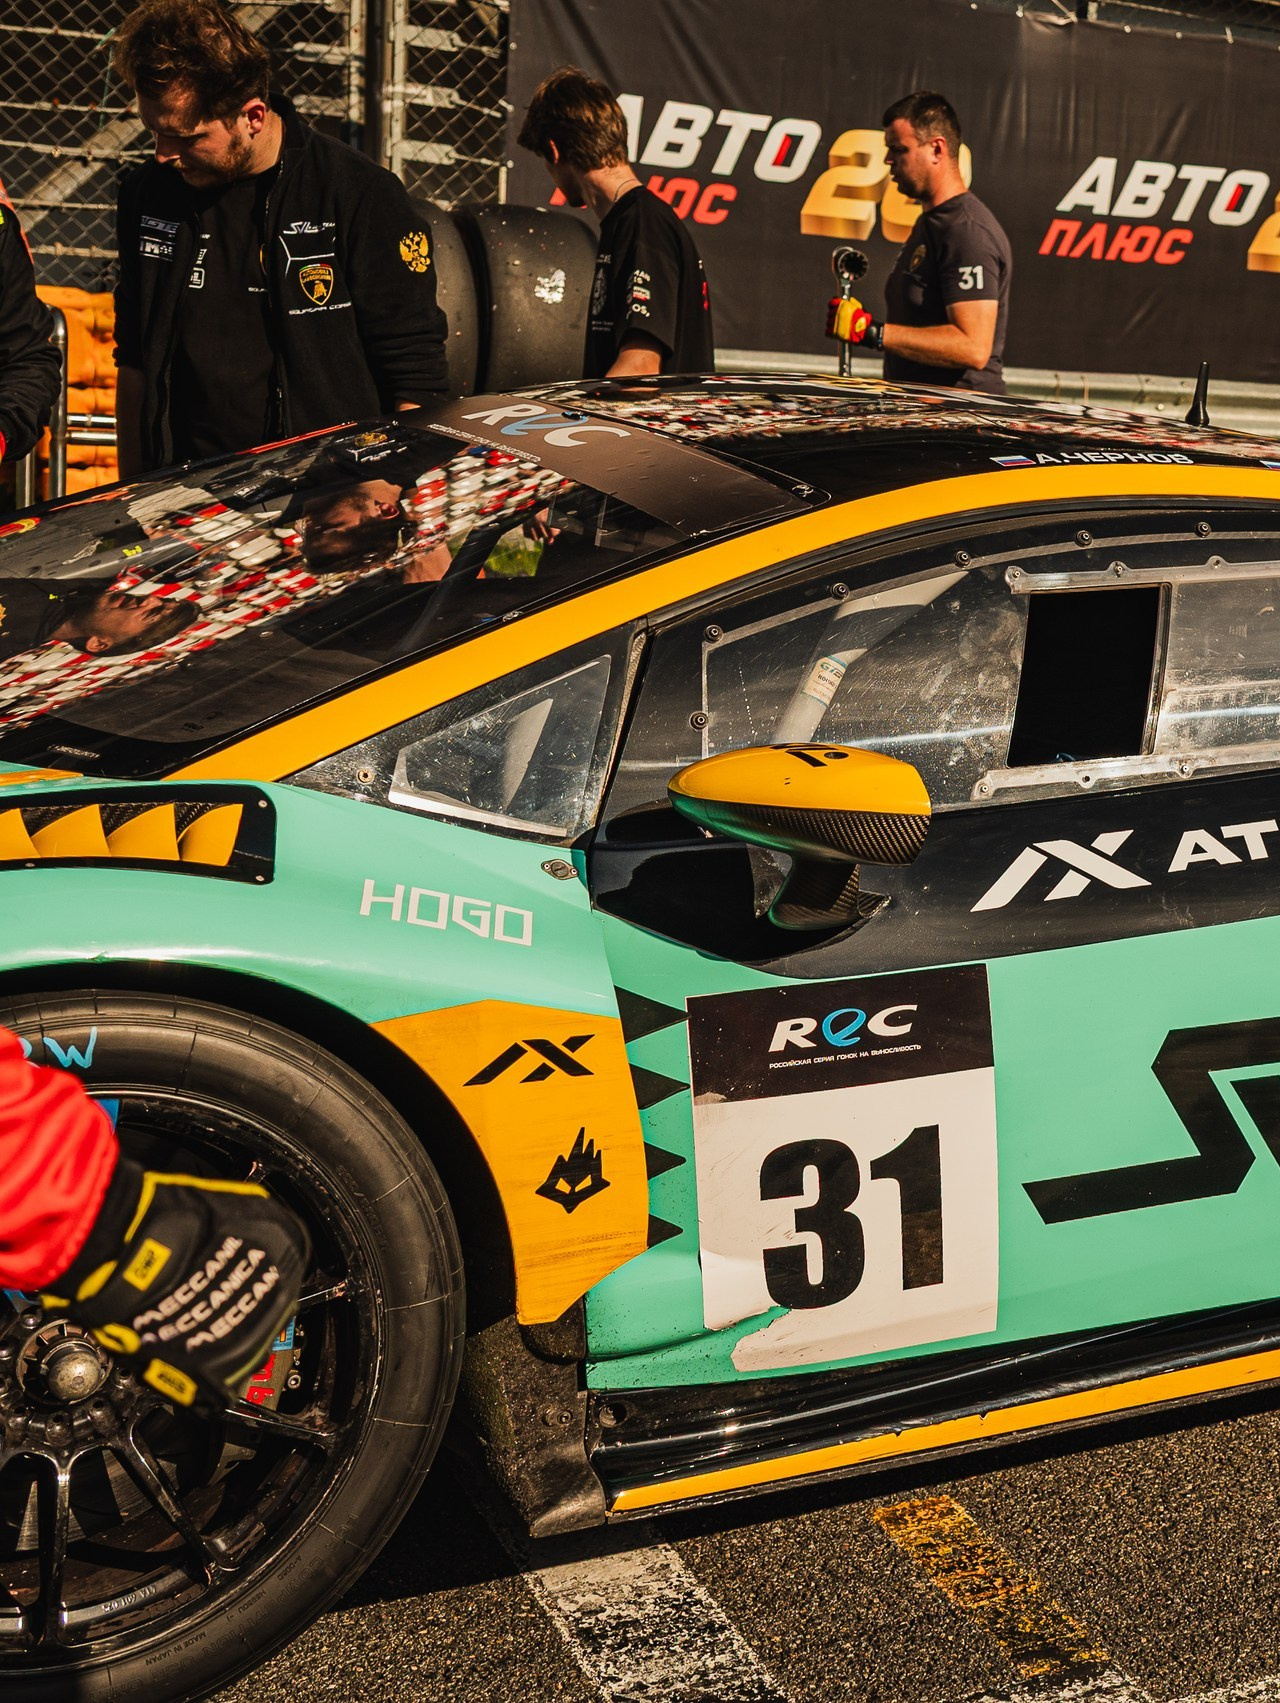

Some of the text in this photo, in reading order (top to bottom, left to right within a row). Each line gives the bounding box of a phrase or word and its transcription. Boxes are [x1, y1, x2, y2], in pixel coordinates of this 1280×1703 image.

[1056, 156, 1270, 227] АВТО
[1038, 219, 1194, 265] ПЛЮС
[958, 264, 985, 291] 31
[359, 878, 534, 948] HOGO
[769, 1044, 922, 1070] РОССИЙСКАЯ СЕРИЯ ГОНОК НА ВЫНОСЛИВОСТЬ
[759, 1123, 945, 1310] 31
